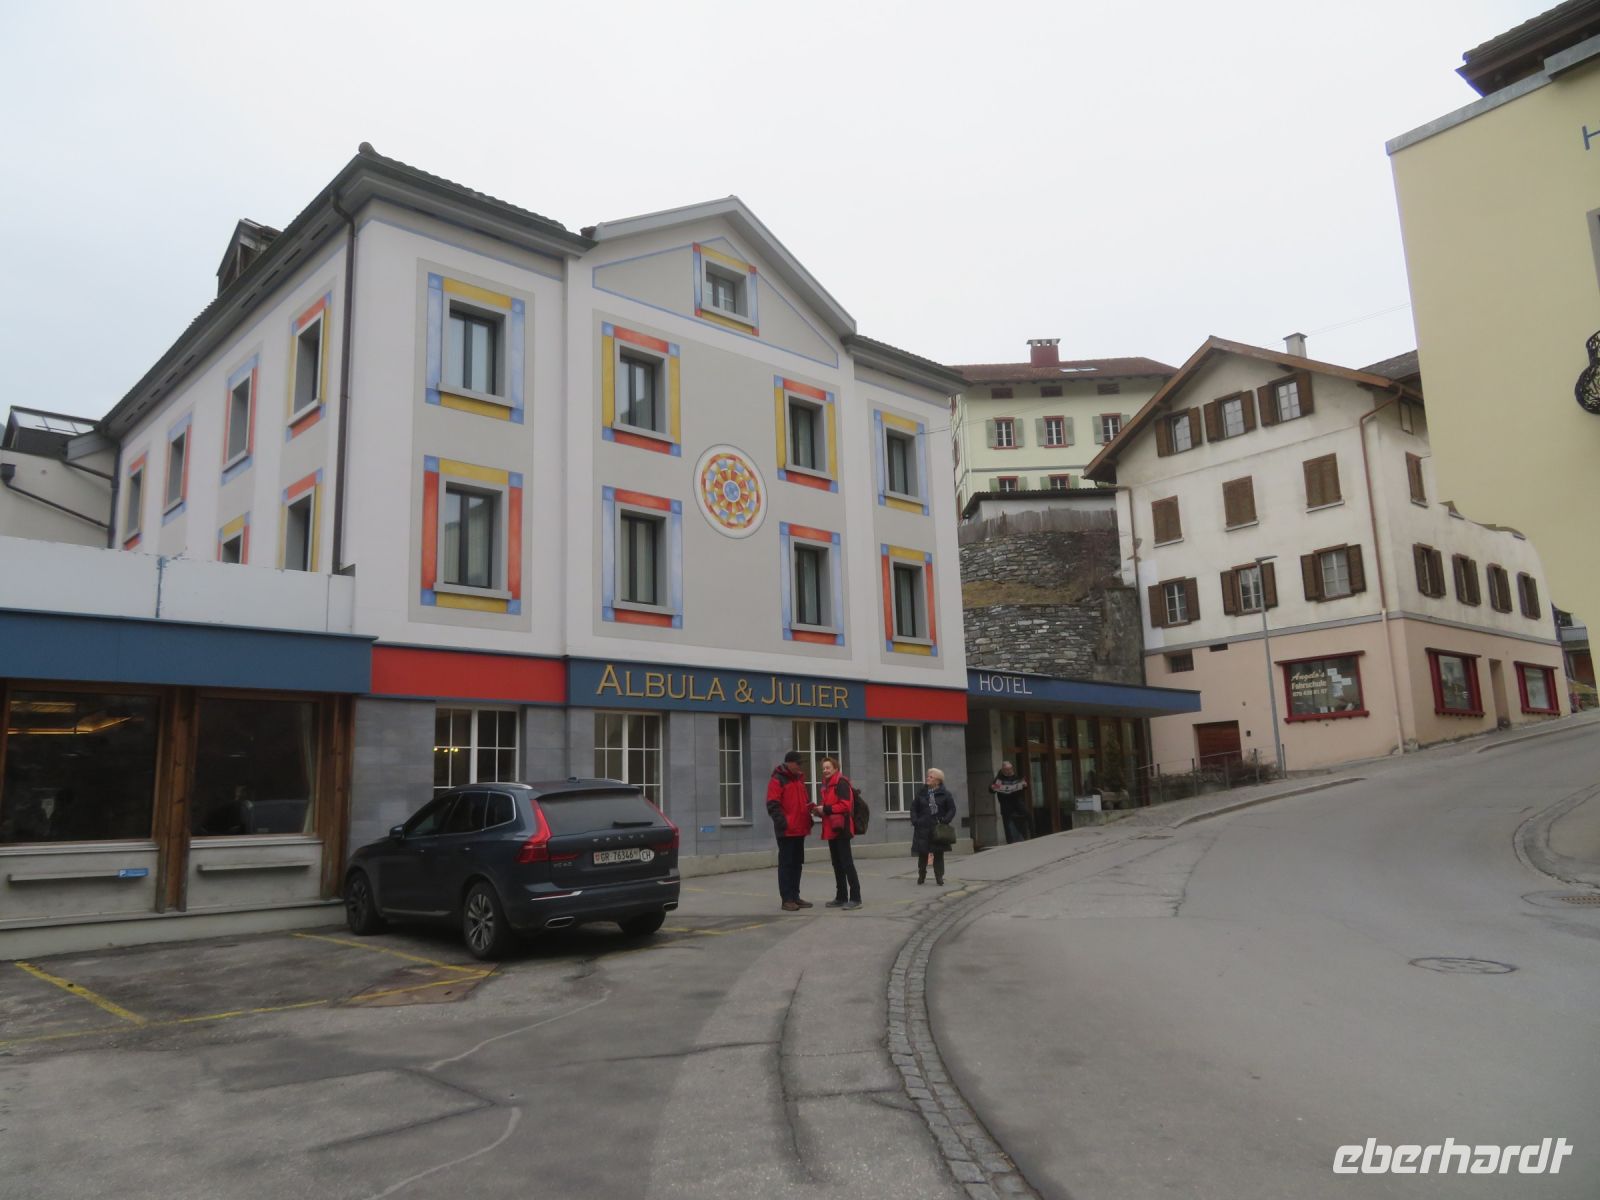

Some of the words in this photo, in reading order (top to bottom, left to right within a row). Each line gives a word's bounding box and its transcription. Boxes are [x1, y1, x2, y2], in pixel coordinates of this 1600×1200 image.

[596, 664, 727, 702] ALBULA
[735, 678, 755, 704] &
[761, 676, 849, 709] JULIER
[979, 673, 1033, 694] HOTEL
[1291, 680, 1327, 690] Fahrschule
[600, 851, 609, 863] GR
[641, 849, 652, 861] CH
